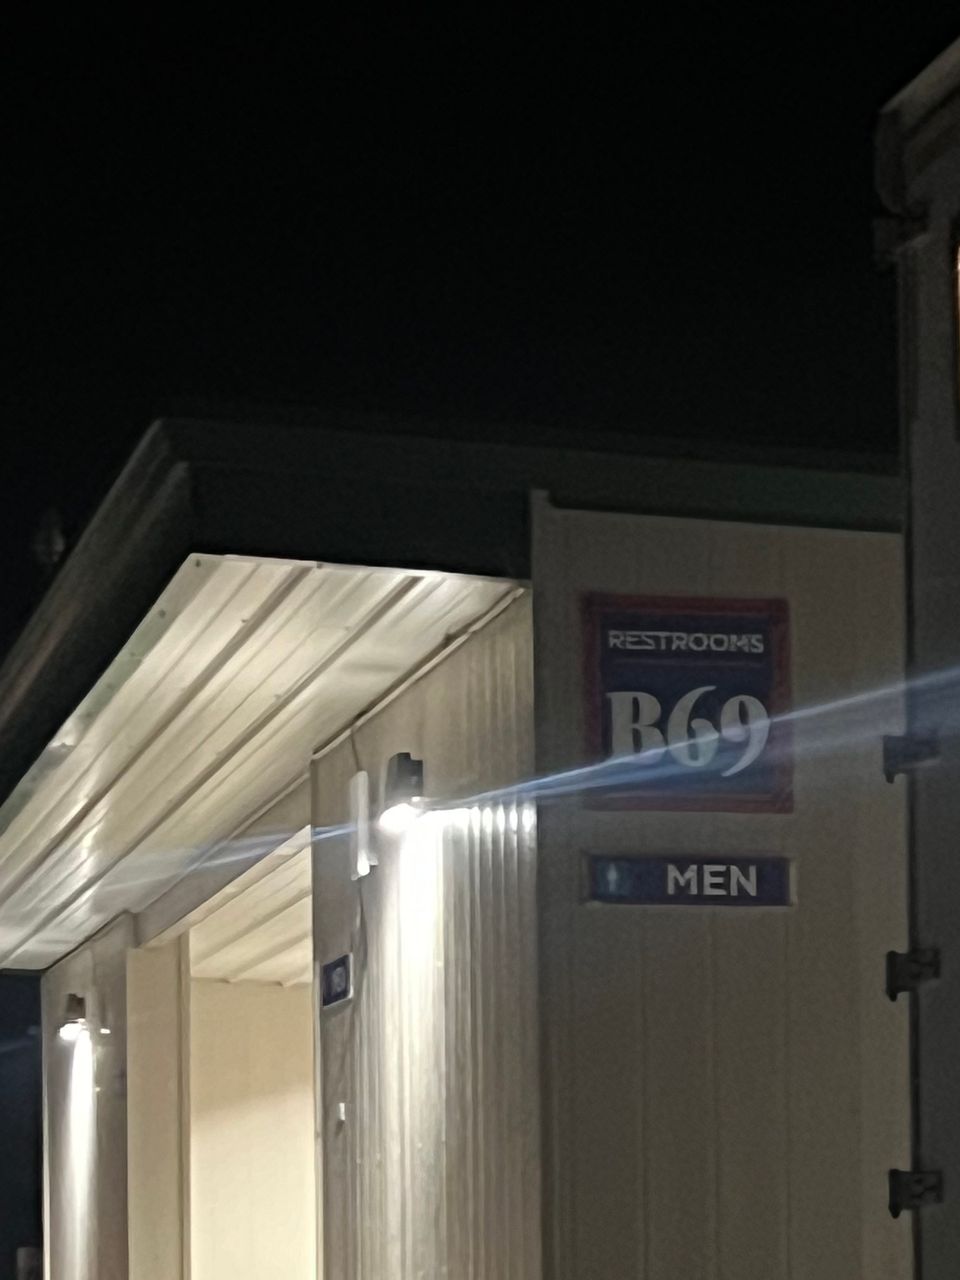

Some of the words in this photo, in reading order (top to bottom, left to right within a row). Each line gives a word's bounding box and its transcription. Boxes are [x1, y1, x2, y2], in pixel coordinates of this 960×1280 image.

[607, 629, 765, 654] RESTROOMS
[605, 684, 771, 777] B69
[666, 863, 758, 897] MEN
